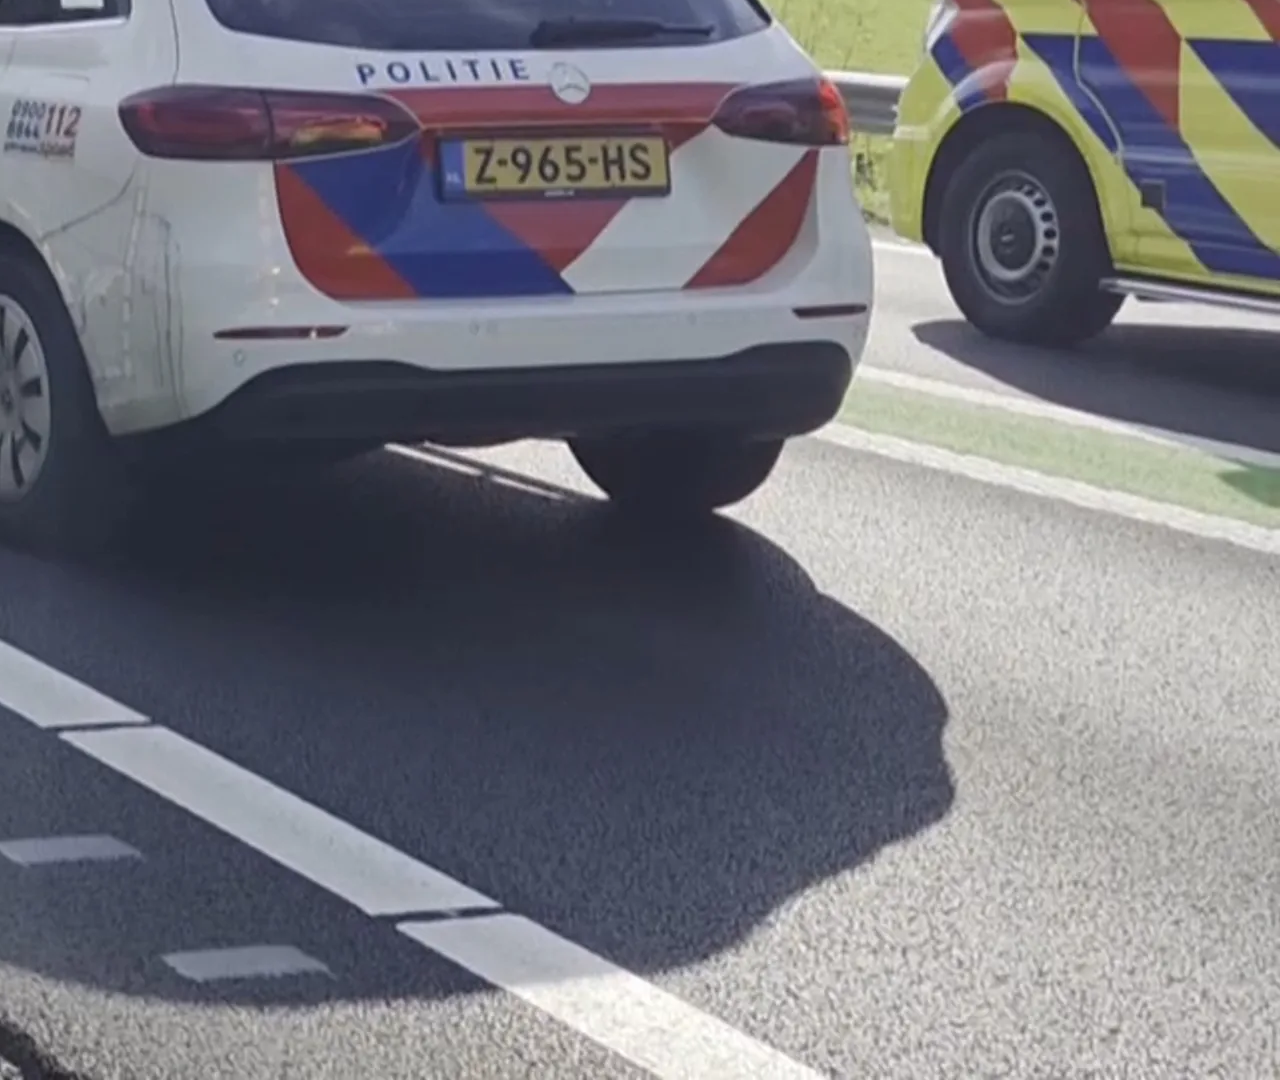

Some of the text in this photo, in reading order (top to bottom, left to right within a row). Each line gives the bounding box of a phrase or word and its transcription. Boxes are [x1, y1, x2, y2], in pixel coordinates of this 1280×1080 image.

[355, 57, 530, 85] POLITIE
[45, 104, 82, 137] 112
[474, 143, 652, 185] Z-965-HS
